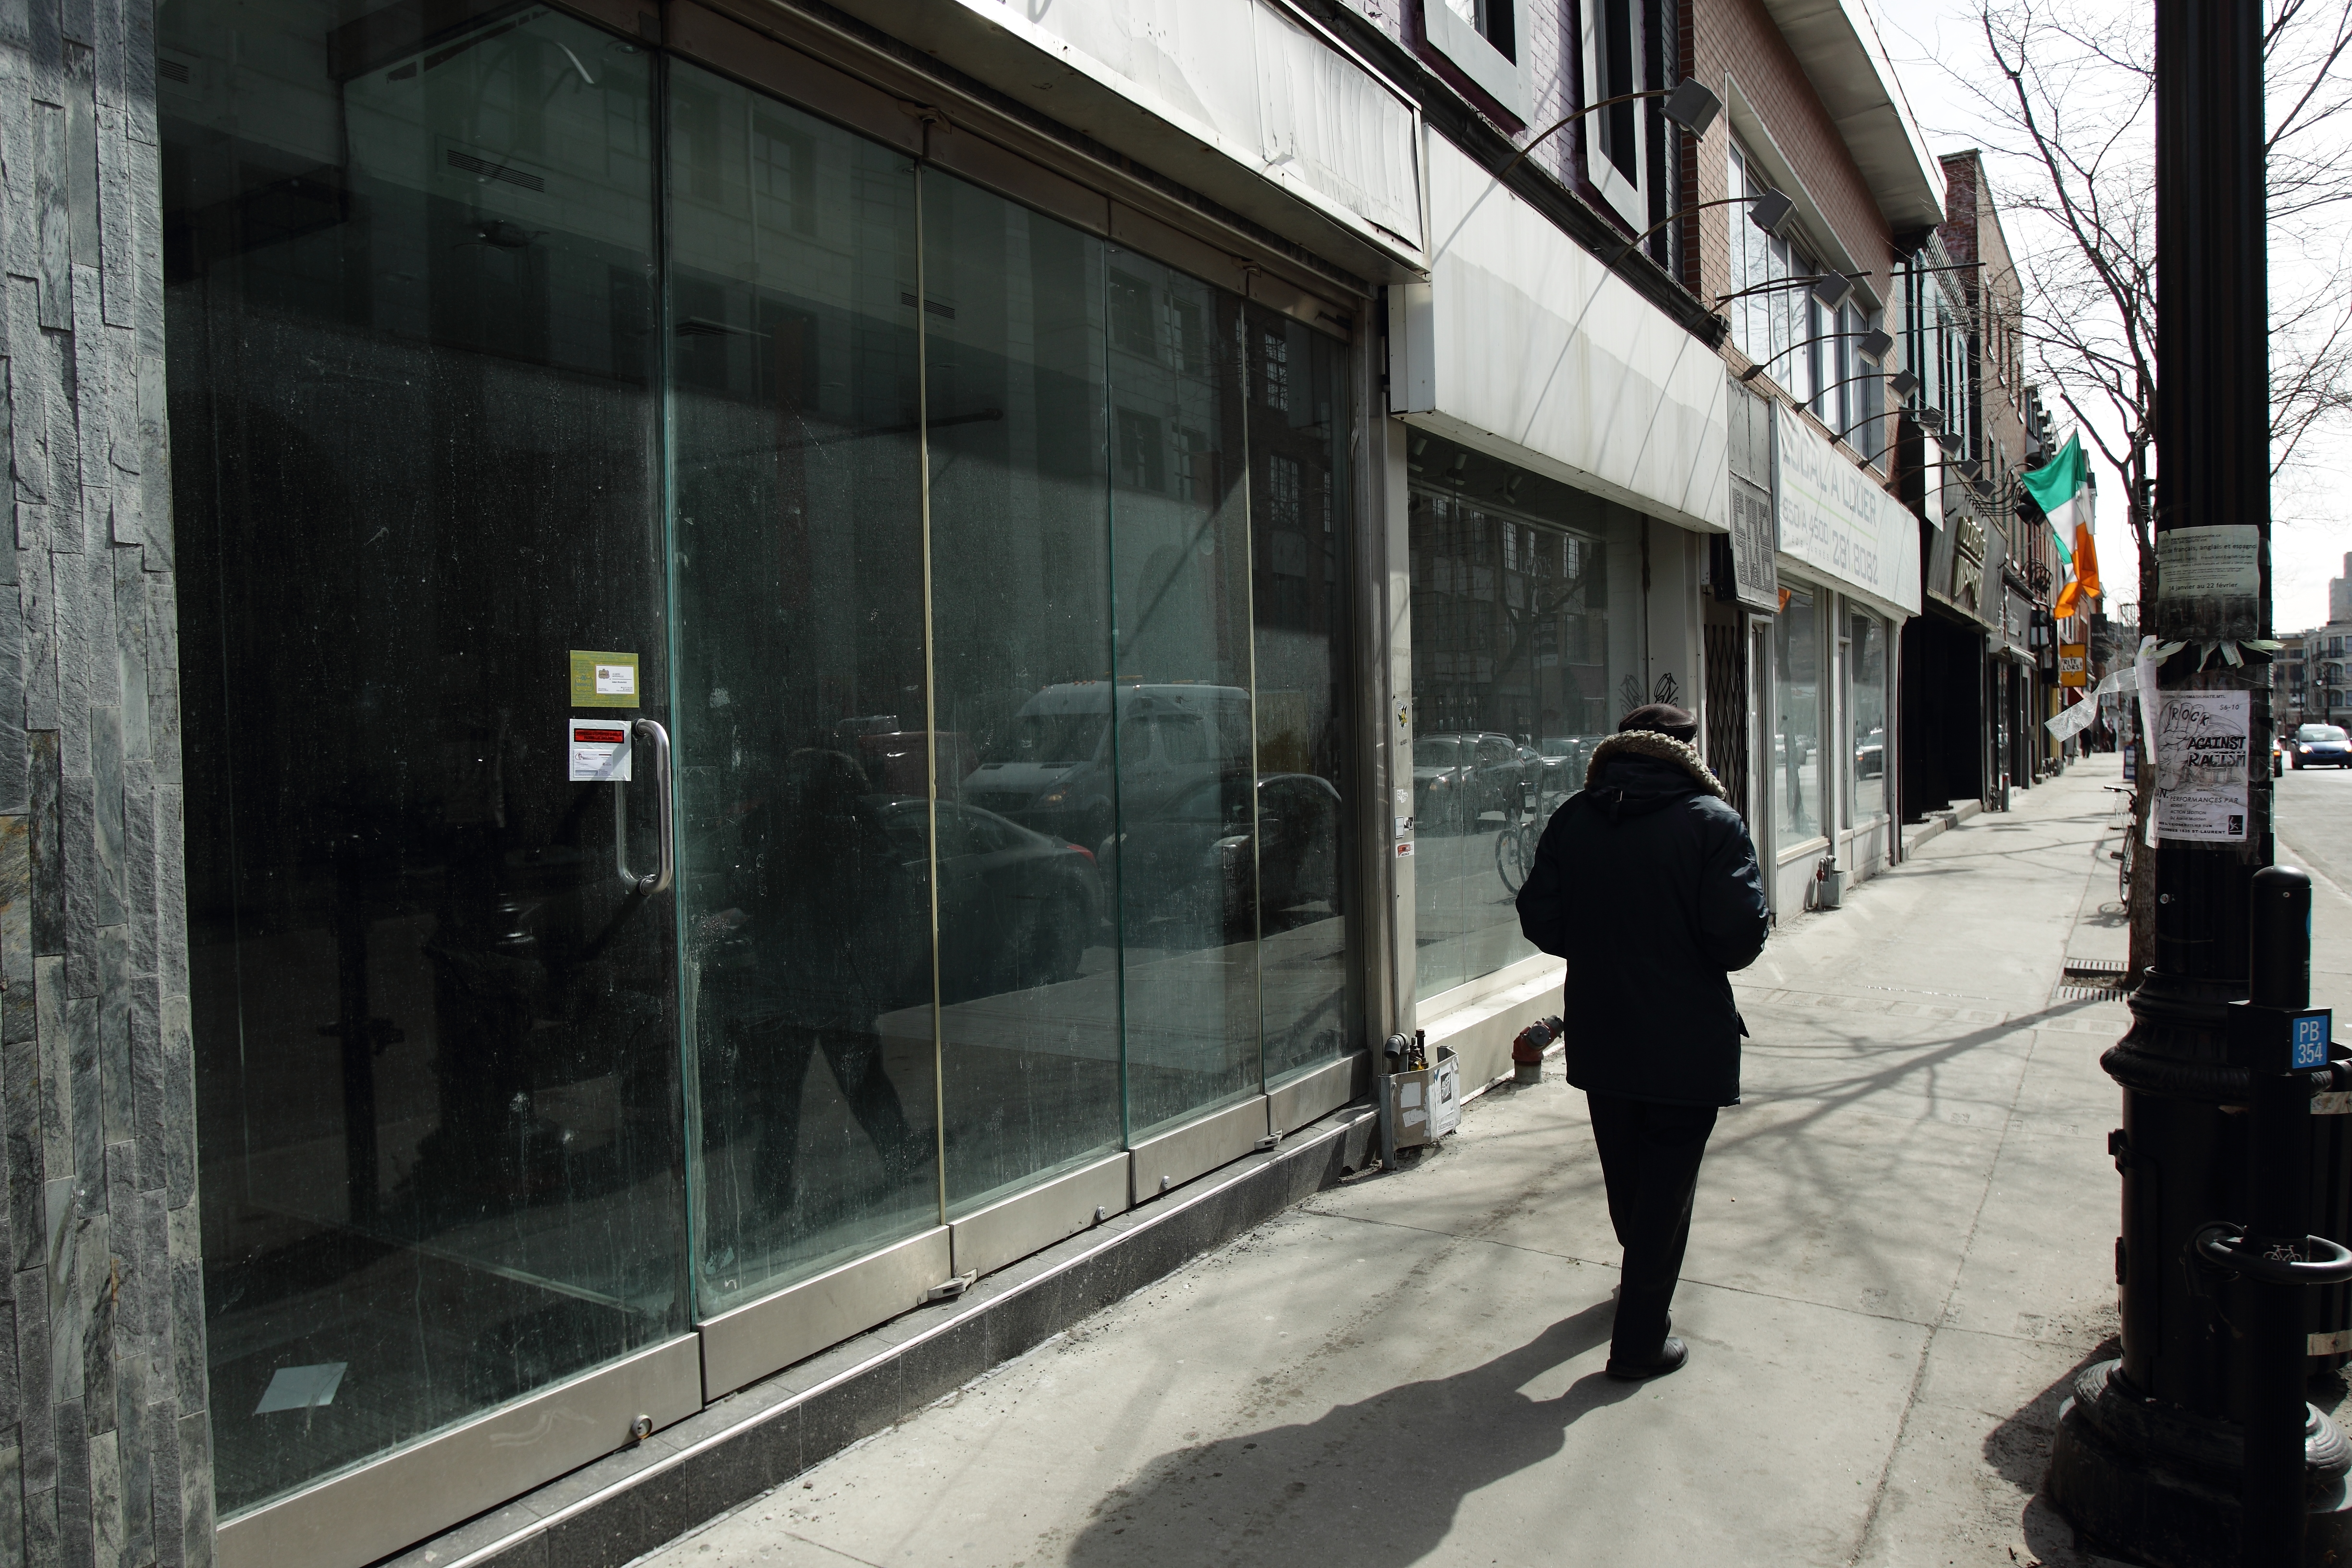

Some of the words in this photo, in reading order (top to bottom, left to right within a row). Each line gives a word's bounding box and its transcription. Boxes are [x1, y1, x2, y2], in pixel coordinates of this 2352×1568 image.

[1783, 425, 1827, 493] LOCAL
[1842, 469, 1876, 527] LOUER
[1783, 496, 1800, 529] 850
[1801, 502, 1808, 534] À
[1809, 514, 1828, 545] 4500
[1783, 530, 1803, 548] PIEDS
[1832, 529, 1878, 586] 281.8082
[2170, 707, 2210, 726] ROCK
[2186, 735, 2246, 750] AGAINST
[2187, 750, 2246, 768] RACISM
[2299, 1021, 2320, 1042] PB
[2298, 1042, 2323, 1065] 354
